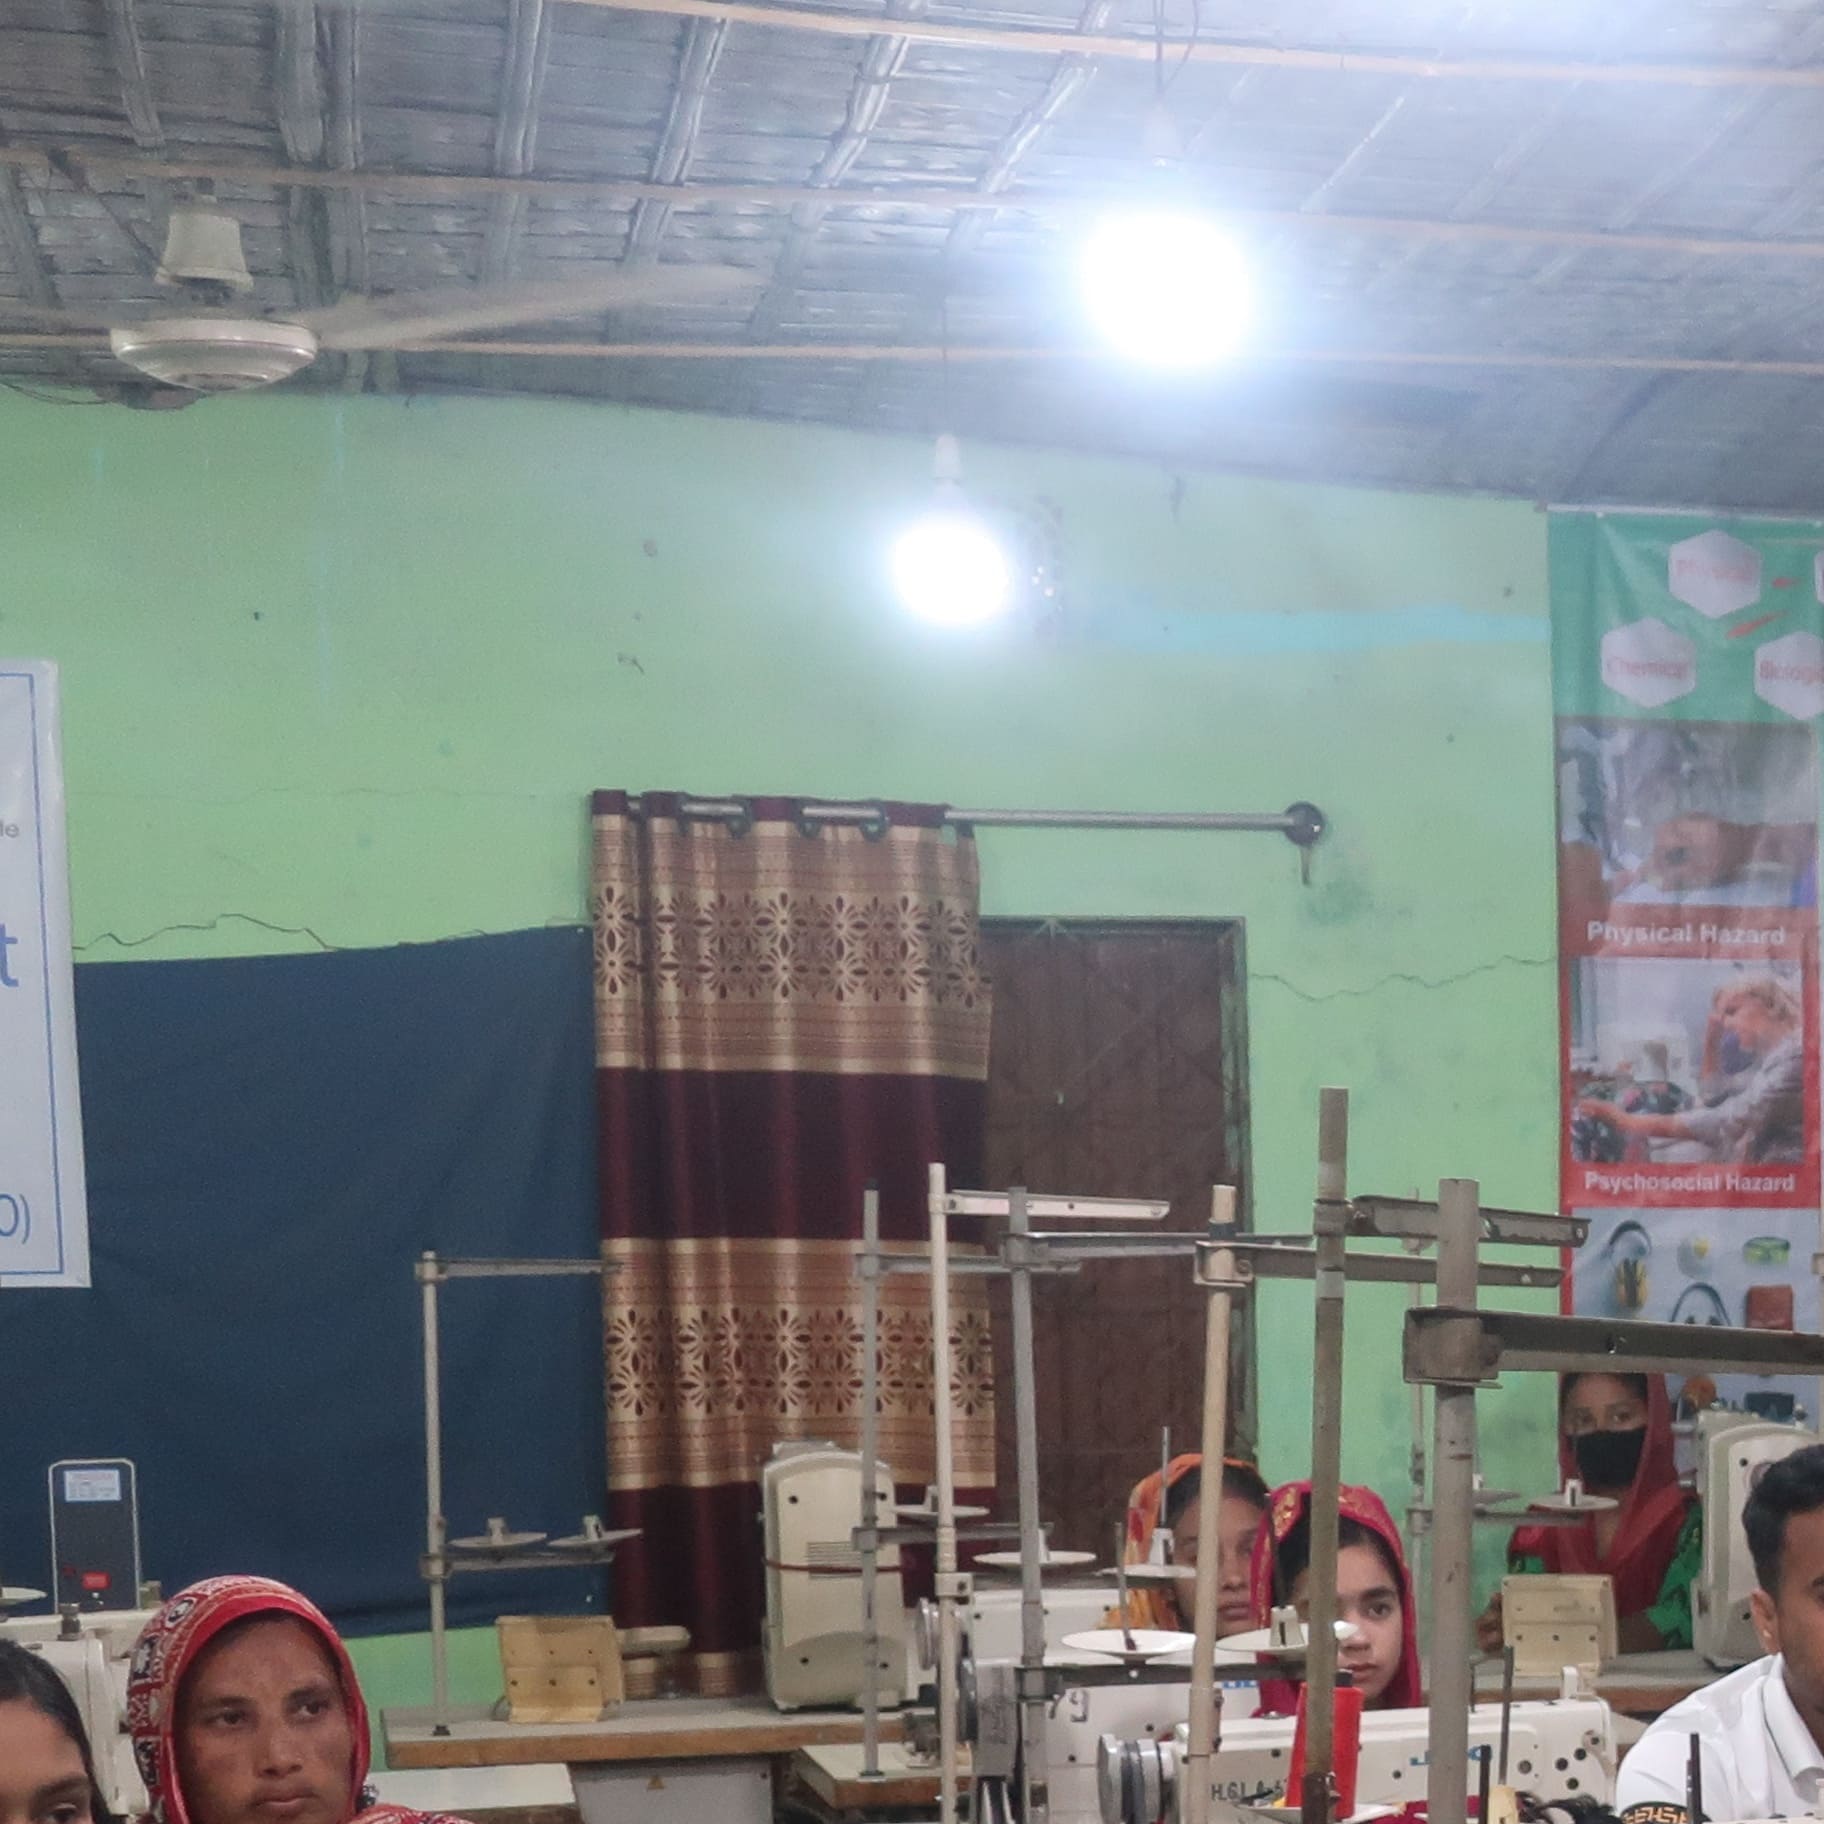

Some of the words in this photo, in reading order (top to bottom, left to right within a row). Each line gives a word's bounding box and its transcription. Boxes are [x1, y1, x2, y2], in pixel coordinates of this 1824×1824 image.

[1587, 920, 1692, 947] Physical
[1700, 923, 1787, 946] Hazard
[1584, 1171, 1720, 1196] Psychosocial
[1726, 1174, 1796, 1194] Hazard
